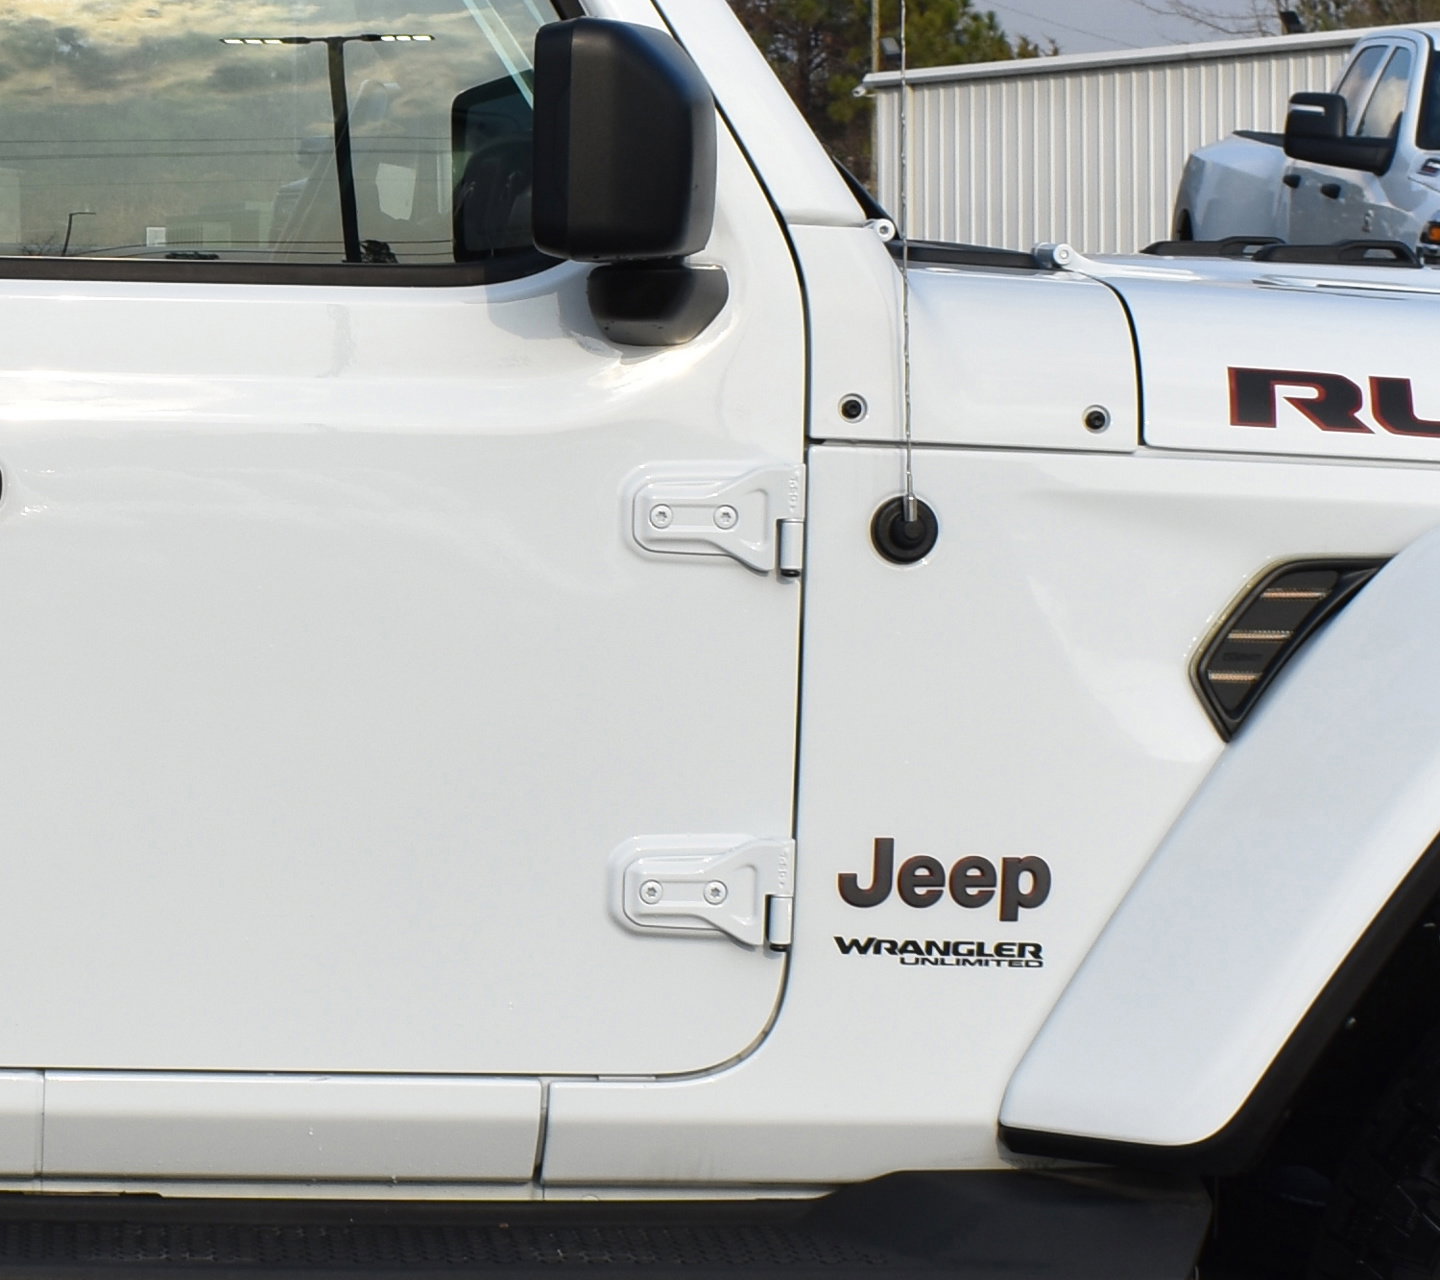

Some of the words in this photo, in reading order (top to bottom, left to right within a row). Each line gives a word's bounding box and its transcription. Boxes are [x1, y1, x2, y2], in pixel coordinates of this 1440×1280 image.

[837, 836, 1052, 922] Jeep
[833, 936, 1043, 959] WRANGLER
[899, 956, 1043, 968] UNLIMITED
